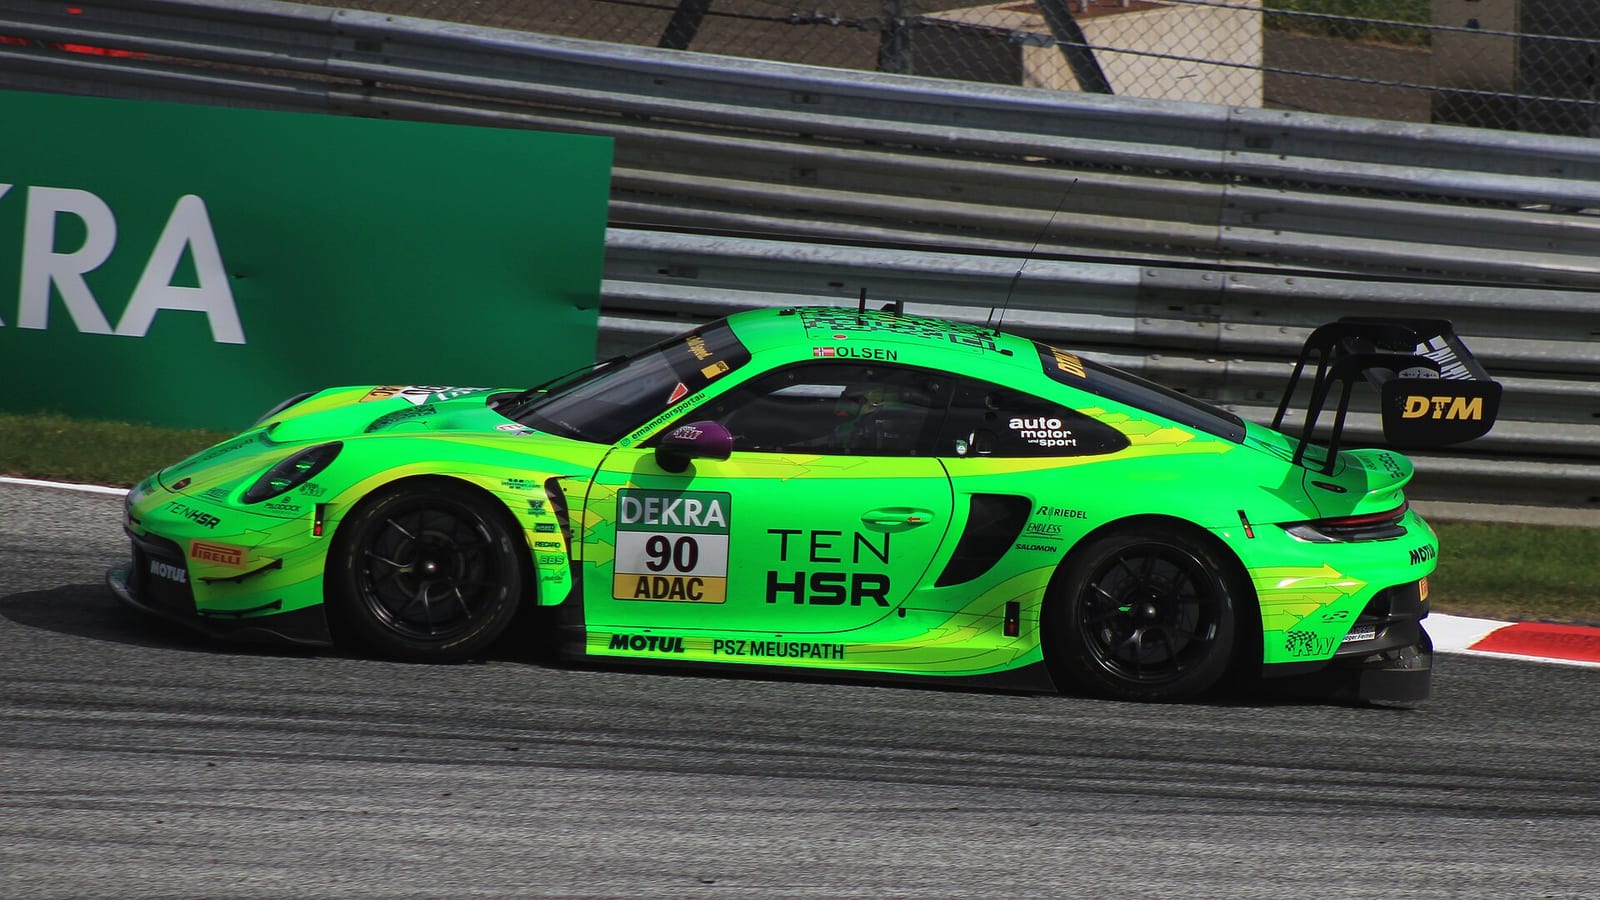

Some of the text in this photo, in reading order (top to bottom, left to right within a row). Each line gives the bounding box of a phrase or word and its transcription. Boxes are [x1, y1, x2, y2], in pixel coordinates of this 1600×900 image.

[0, 183, 247, 345] RA
[836, 346, 898, 361] OLSEN
[632, 392, 706, 440] emamotorsportau
[1402, 396, 1483, 420] DTM
[1009, 417, 1061, 430] auto
[1020, 429, 1072, 439] motor
[1039, 439, 1077, 448] sport
[620, 496, 727, 528] DEKRA
[1054, 508, 1088, 520] RIEDEL
[1026, 522, 1063, 534] ENDLESS
[191, 542, 242, 566] PIRELLI
[645, 535, 700, 573] 90
[767, 528, 891, 565] TEN
[1016, 543, 1057, 553] SALOMON
[150, 560, 188, 584] MOTUL
[634, 575, 705, 601] ADAC
[765, 570, 891, 607] HSR
[608, 633, 686, 654] MOTUL
[713, 639, 846, 660] PSZ MEUSPATH
